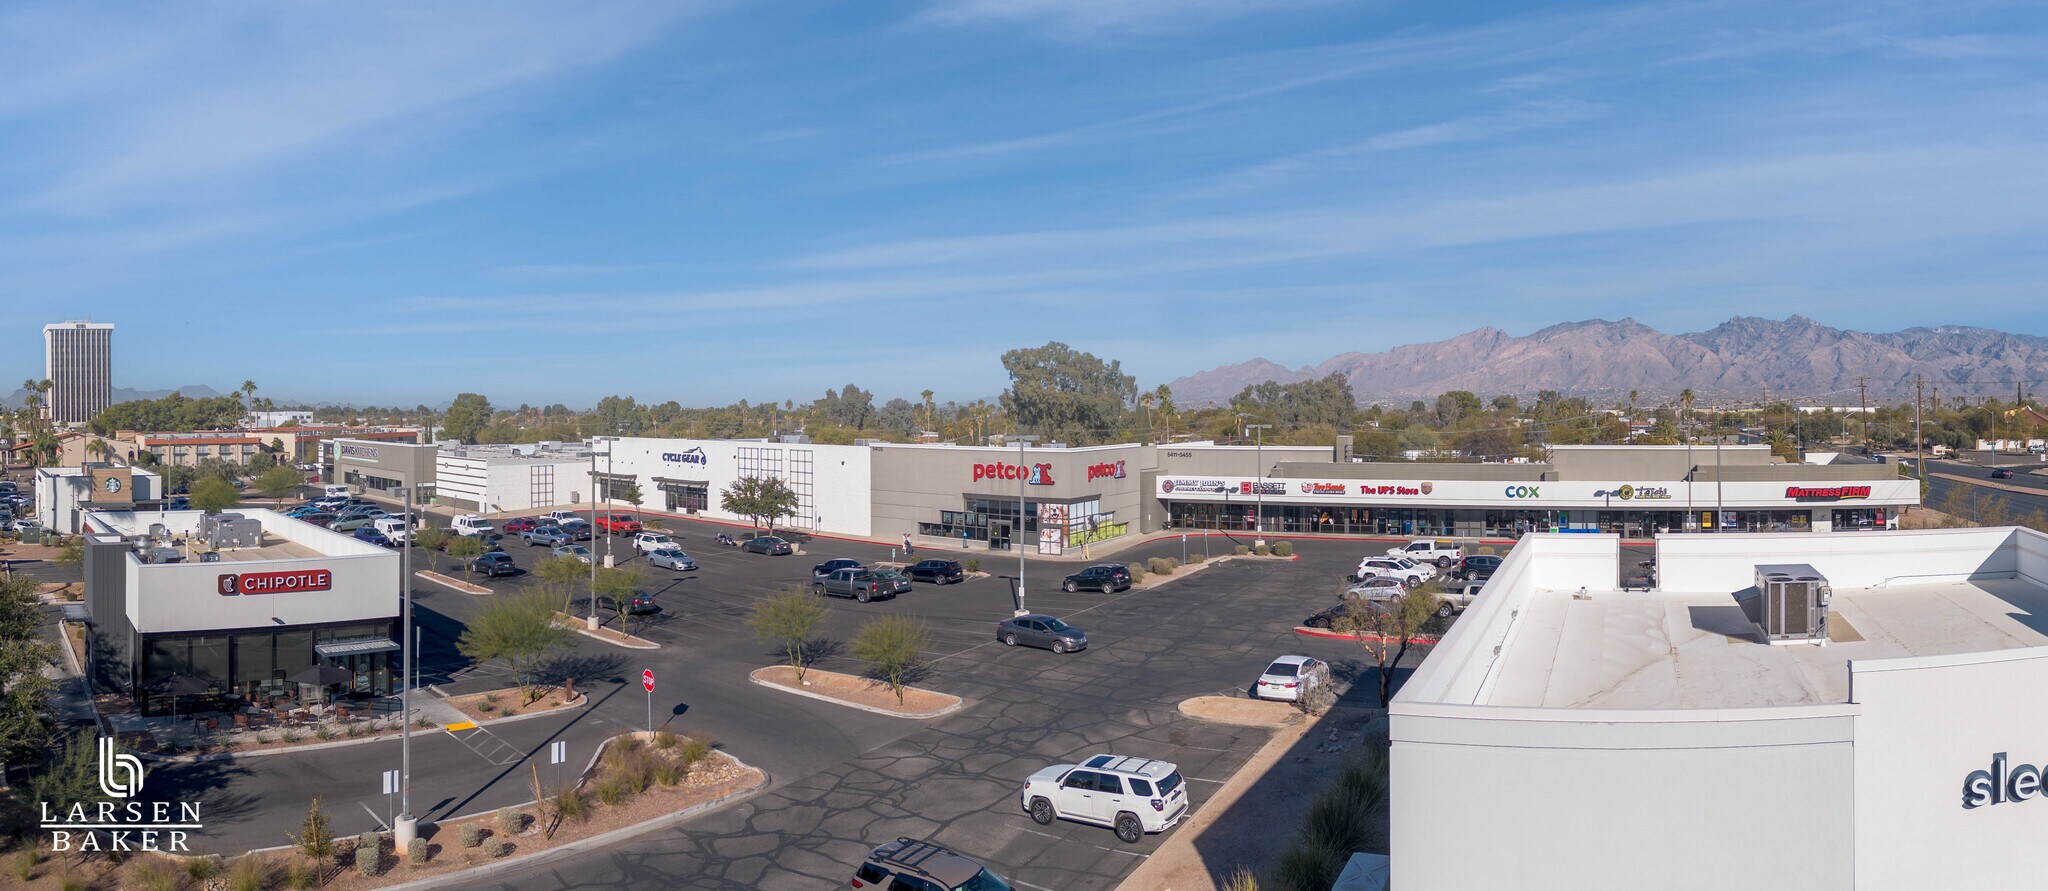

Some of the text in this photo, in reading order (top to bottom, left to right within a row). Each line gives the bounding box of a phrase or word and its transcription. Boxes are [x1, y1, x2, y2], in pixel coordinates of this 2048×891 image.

[662, 452, 700, 464] CYCLE GEAR
[973, 461, 1029, 482] petco
[1087, 462, 1115, 482] petco
[1174, 479, 1199, 487] JIMMY
[1252, 482, 1287, 491] BASSETT
[1360, 485, 1419, 496] The UPS Store
[1505, 485, 1540, 498] COX
[1840, 486, 1872, 497] FIRM
[244, 573, 327, 591] CHIPOTLE
[643, 675, 654, 686] STOP
[1961, 751, 2047, 809] sle
